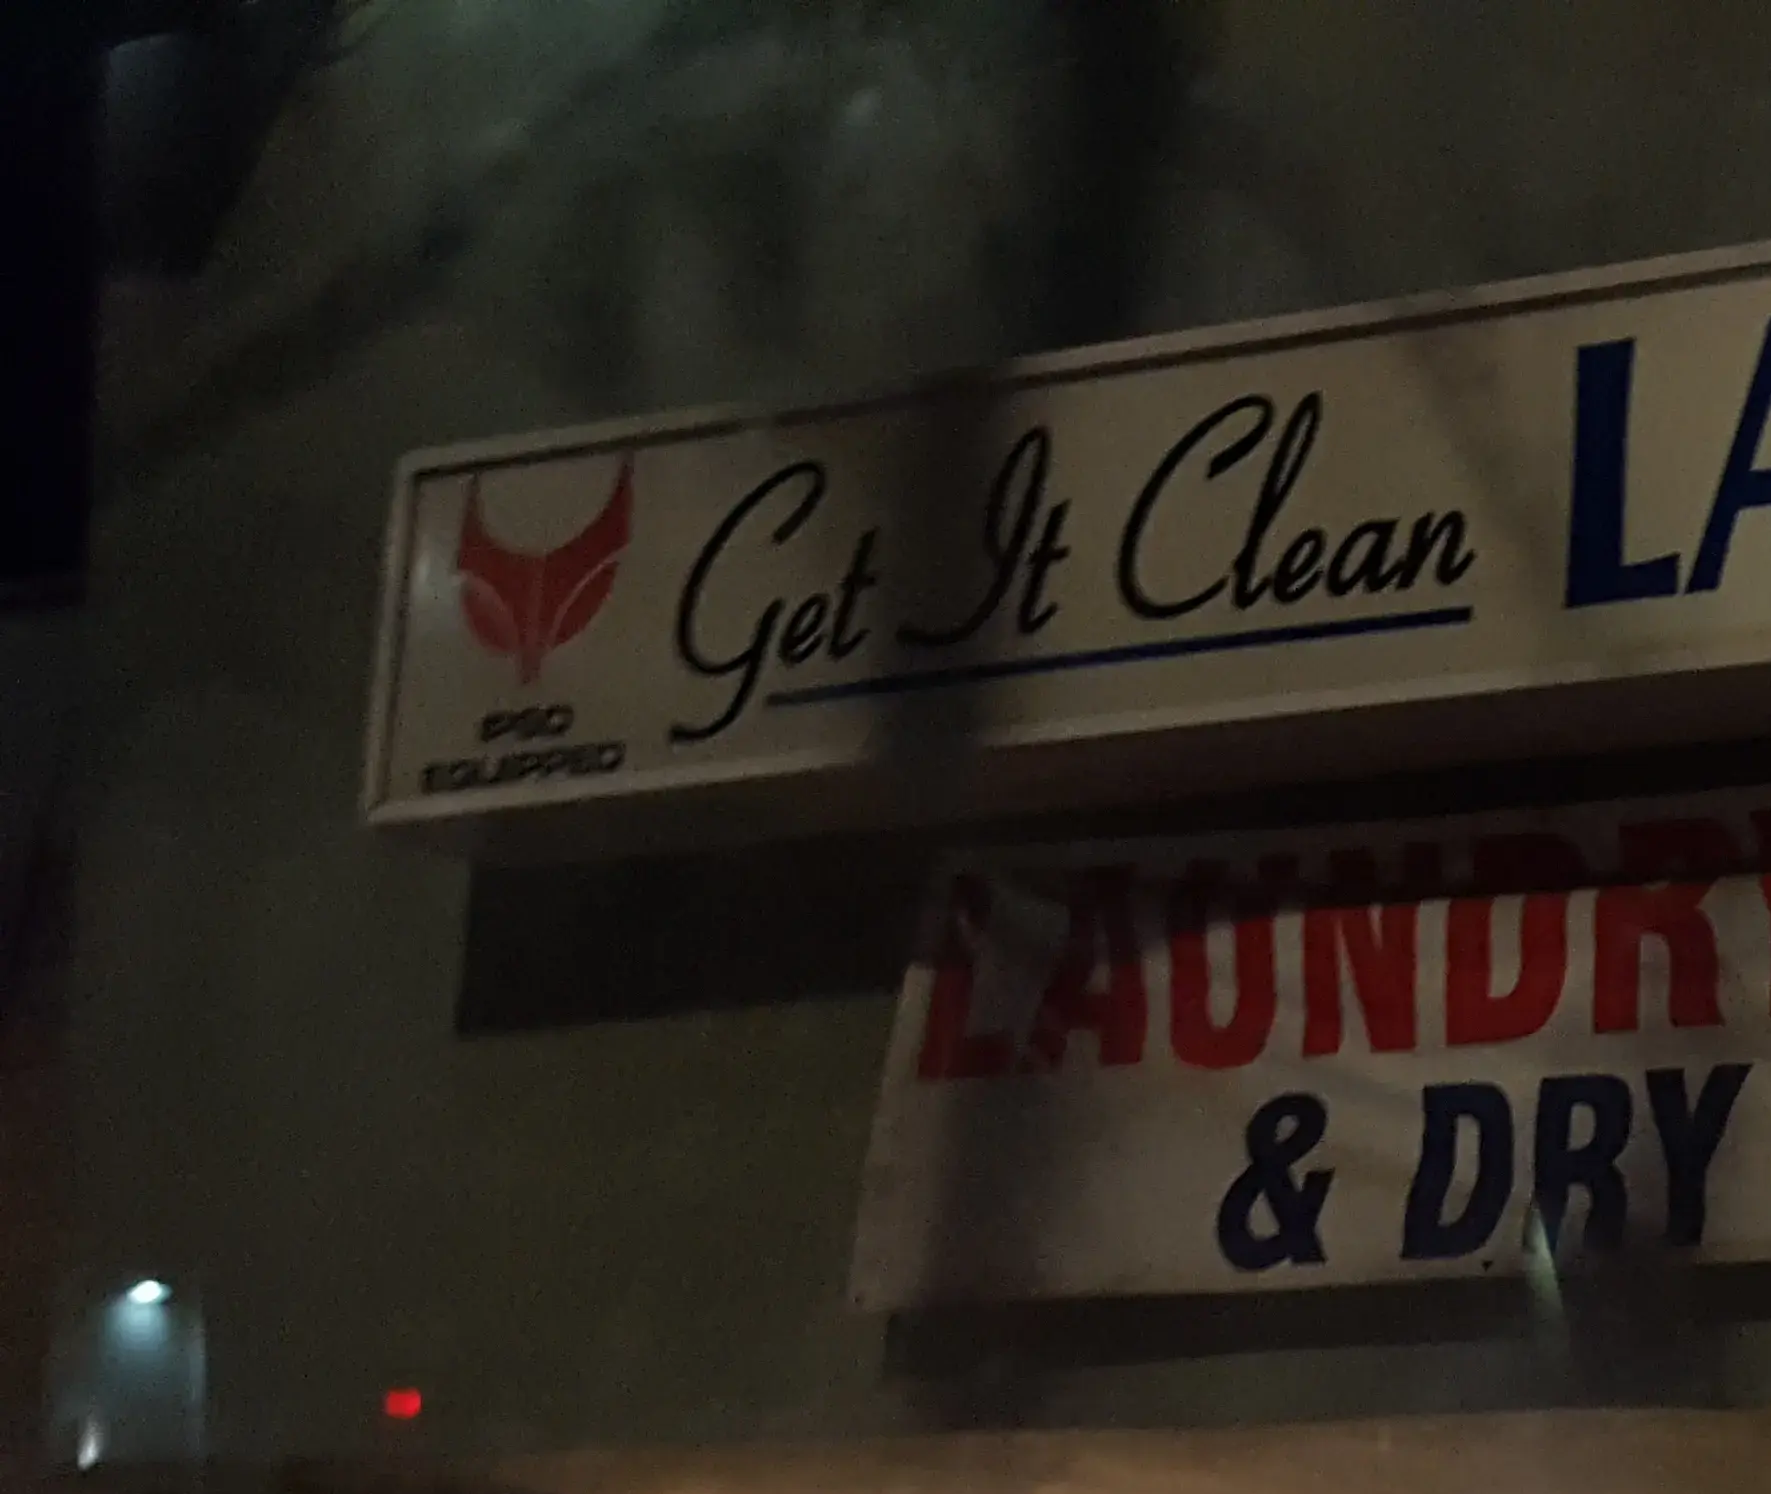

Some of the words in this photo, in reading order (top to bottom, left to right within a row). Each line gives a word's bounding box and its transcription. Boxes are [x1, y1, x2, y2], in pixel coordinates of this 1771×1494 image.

[668, 460, 878, 747] Get
[896, 423, 1070, 648] It
[1117, 390, 1477, 622] Clean
[1217, 1090, 1328, 1272] &
[1401, 1062, 1754, 1260] DRY
